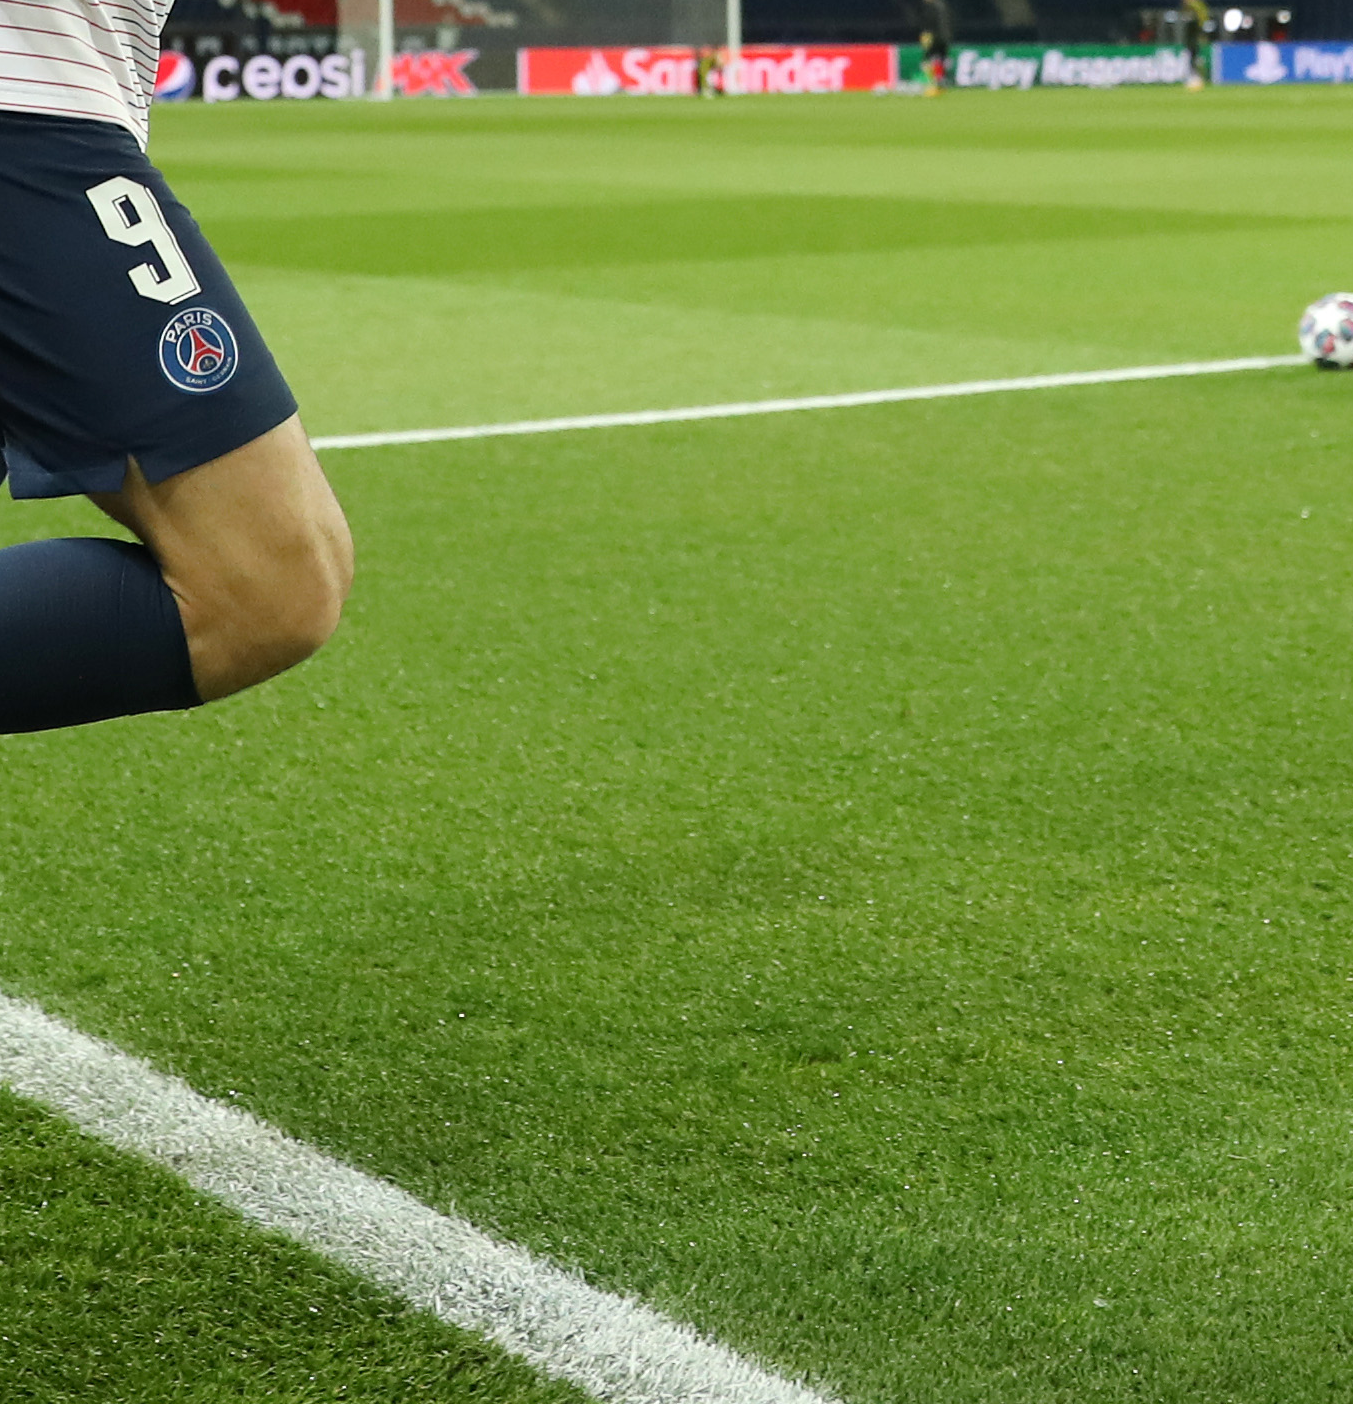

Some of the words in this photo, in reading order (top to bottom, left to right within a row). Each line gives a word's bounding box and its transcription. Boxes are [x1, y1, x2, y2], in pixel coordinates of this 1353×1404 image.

[621, 48, 851, 96] Sanander
[955, 48, 1039, 90] Enjoy
[1042, 48, 1193, 88] Responsibl
[85, 175, 201, 305] 9
[165, 311, 213, 344] PARIS
